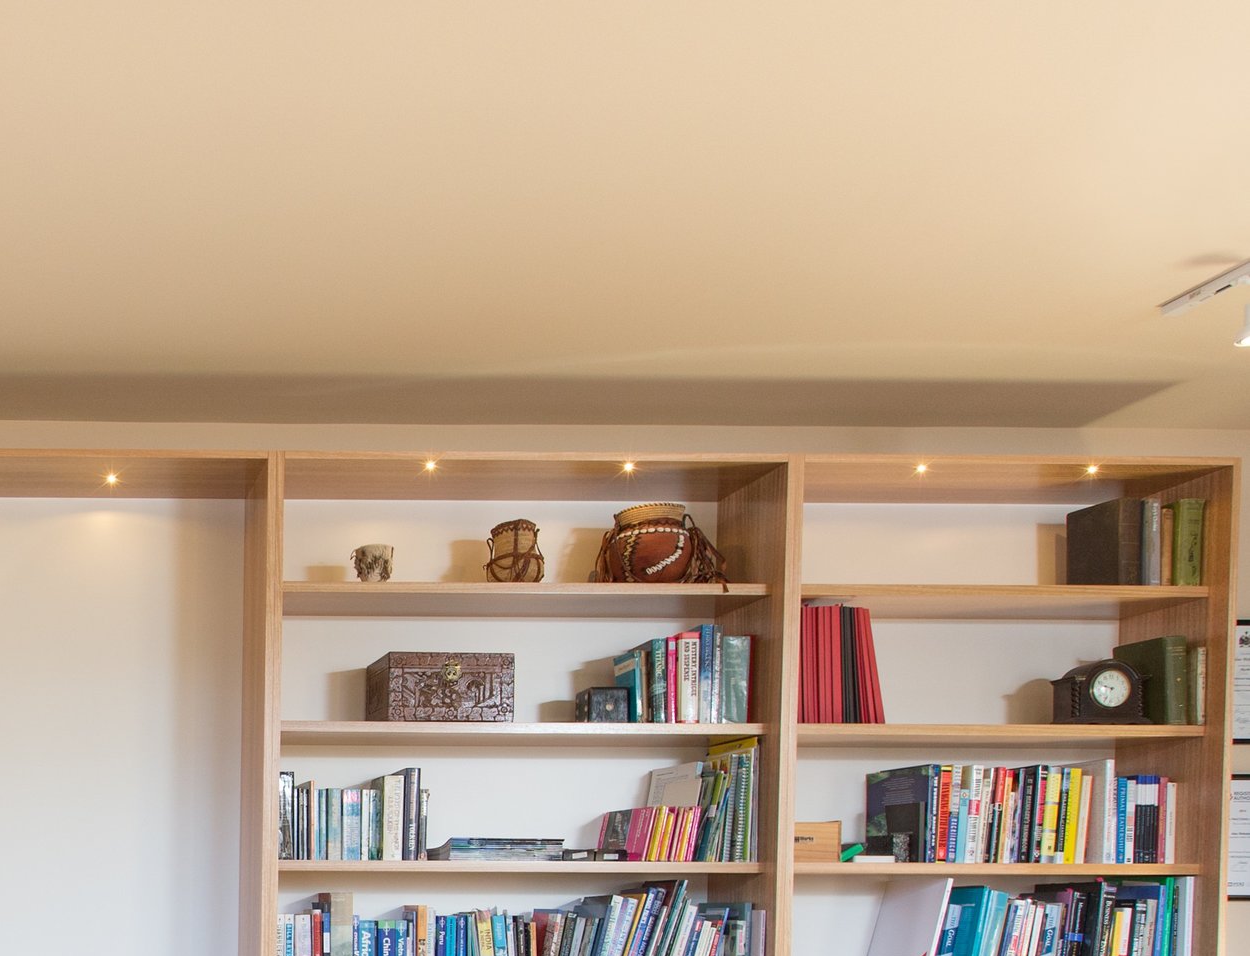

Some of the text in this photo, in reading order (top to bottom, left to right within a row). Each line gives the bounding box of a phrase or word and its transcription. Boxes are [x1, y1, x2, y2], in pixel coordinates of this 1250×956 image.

[938, 782, 951, 848] MANAGING WITH POWER
[1117, 787, 1126, 853] PRIMAL LEADERSHIP
[948, 817, 958, 852] excellence
[968, 816, 978, 843] INNOVATION
[1019, 823, 1029, 852] HANDBOOK
[1102, 900, 1113, 925] BUSINESS
[483, 928, 492, 951] INDIA
[642, 915, 656, 942] SAHARA
